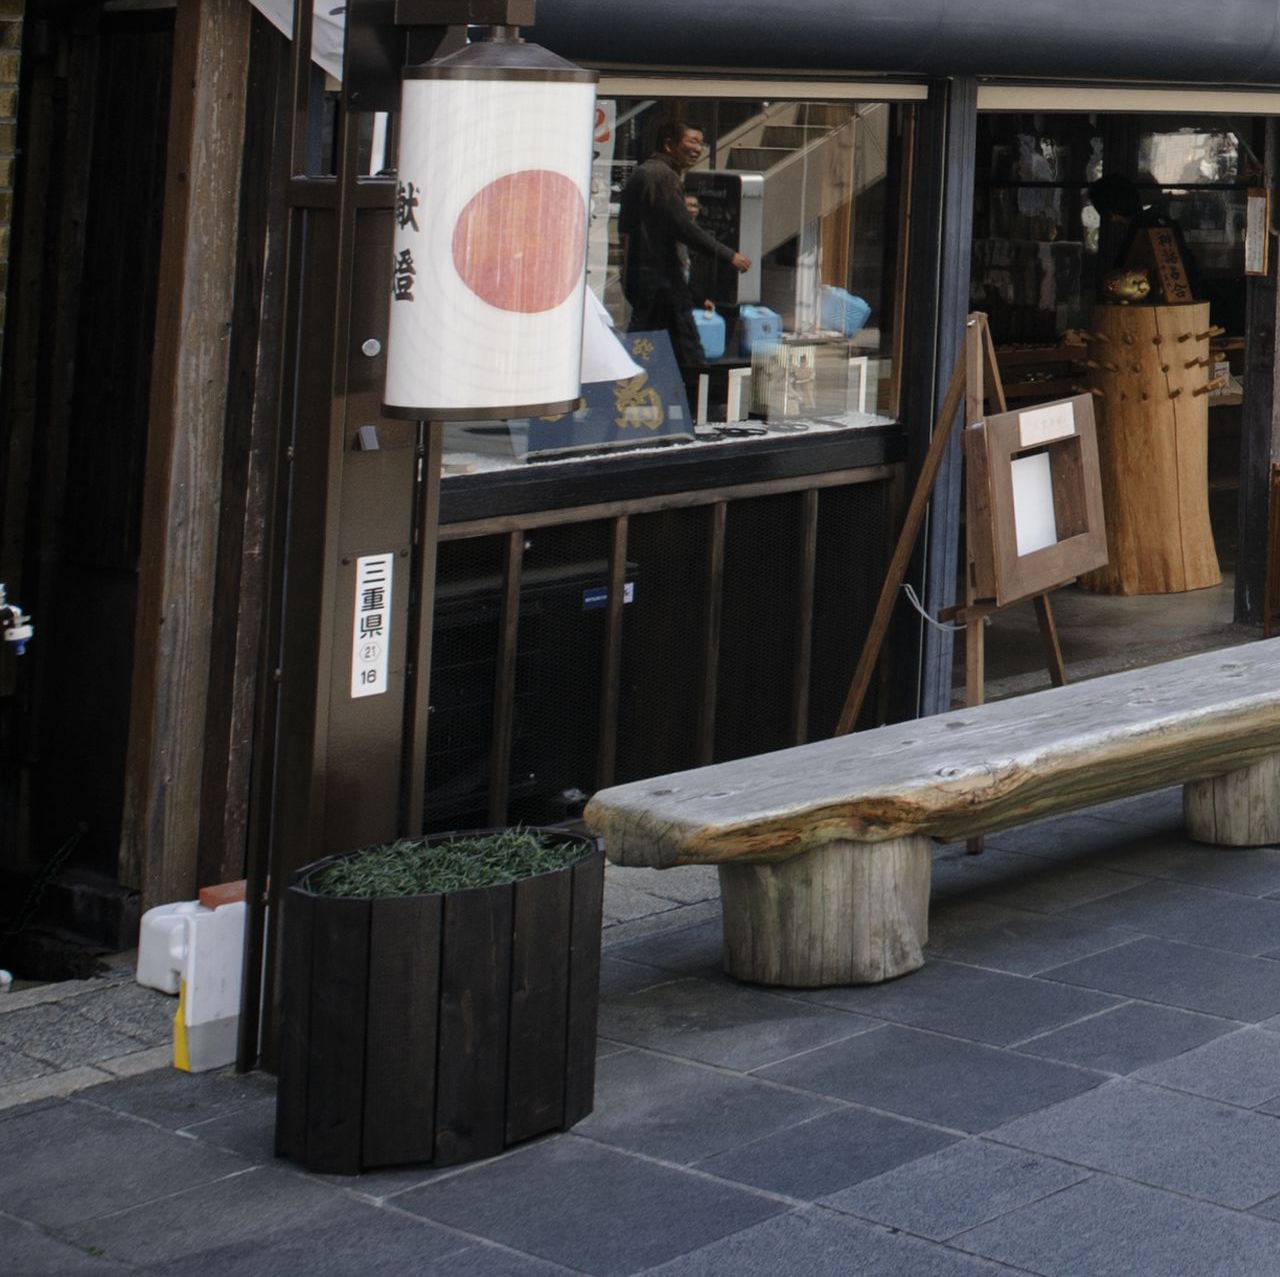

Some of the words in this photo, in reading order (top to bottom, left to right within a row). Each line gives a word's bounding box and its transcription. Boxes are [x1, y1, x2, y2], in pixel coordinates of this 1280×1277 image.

[359, 559, 387, 640] 三重県
[364, 645, 377, 659] 21
